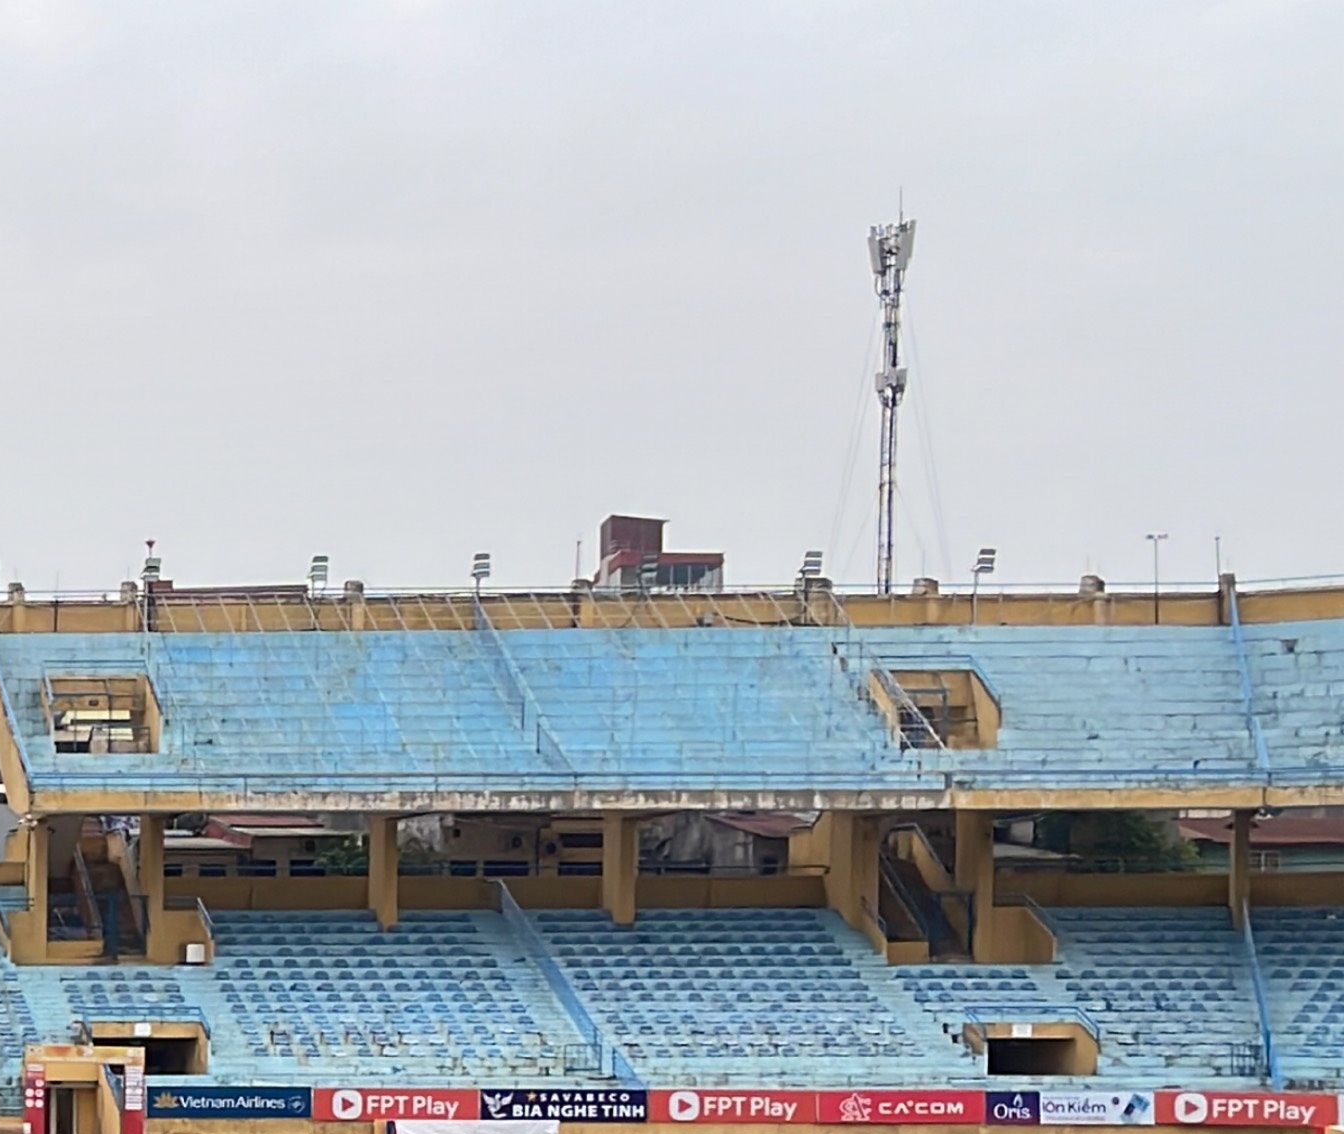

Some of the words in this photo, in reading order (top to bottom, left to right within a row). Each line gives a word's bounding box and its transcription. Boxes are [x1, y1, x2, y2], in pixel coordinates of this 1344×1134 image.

[179, 1096, 234, 1108] Vietnam
[236, 1096, 285, 1108] Airlines
[367, 1096, 408, 1114] FPT
[413, 1096, 459, 1119] Play
[540, 1093, 630, 1102] SAVABECO
[703, 1097, 747, 1115] FPT
[750, 1097, 797, 1120] Play
[993, 1096, 1031, 1119] Oris
[512, 1104, 543, 1117] BIA
[1213, 1099, 1259, 1118] FPT
[1263, 1099, 1316, 1125] Play
